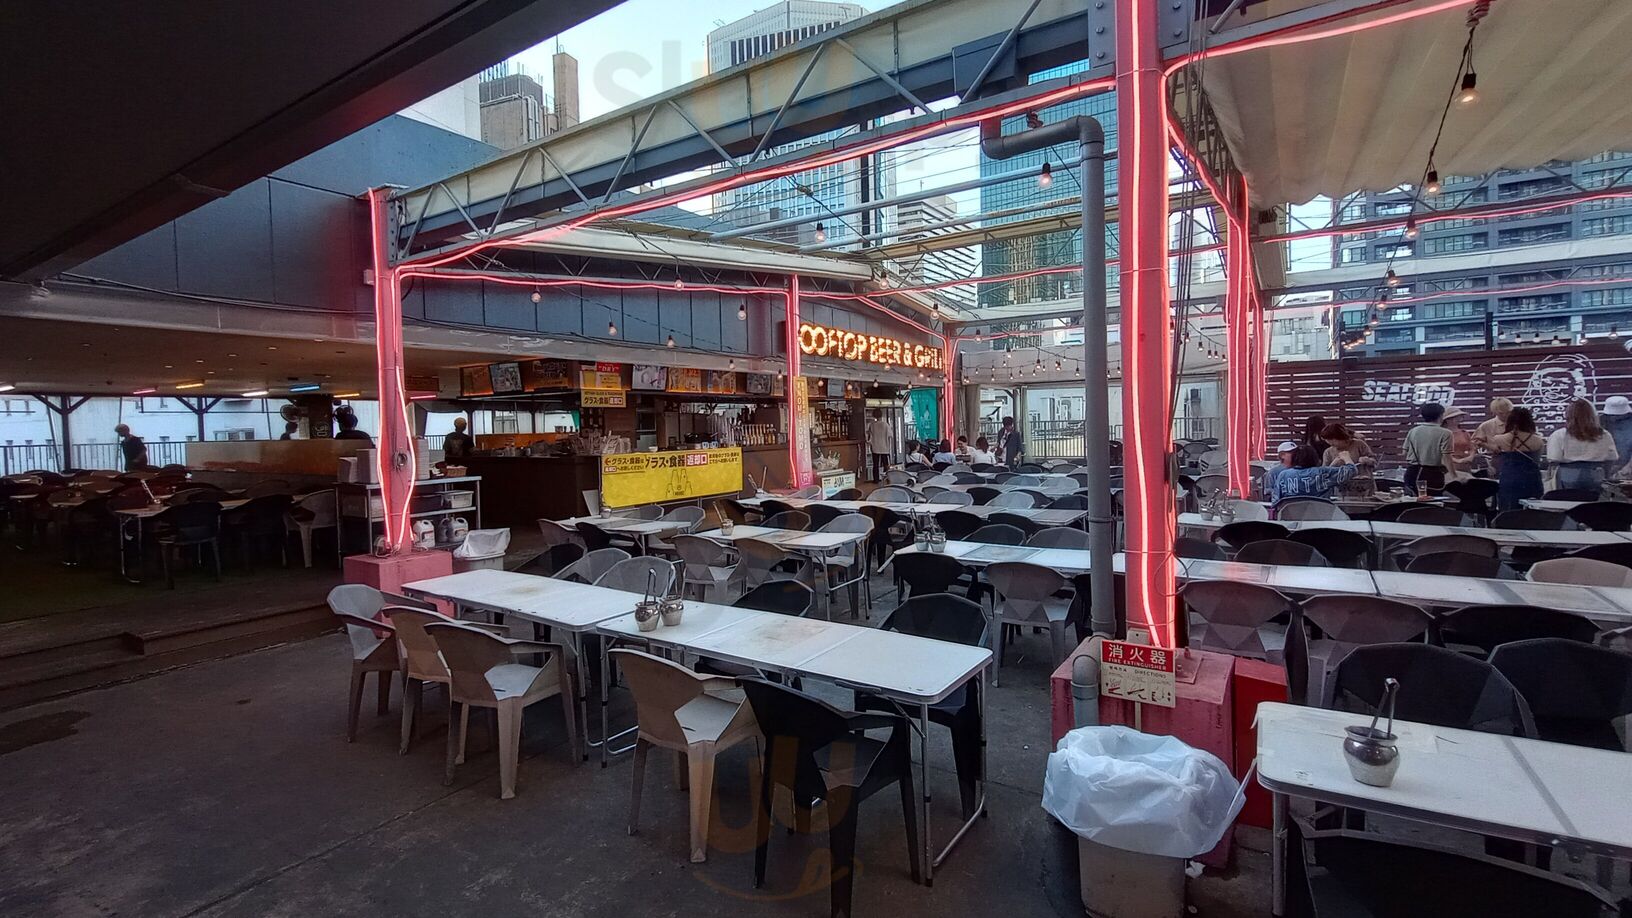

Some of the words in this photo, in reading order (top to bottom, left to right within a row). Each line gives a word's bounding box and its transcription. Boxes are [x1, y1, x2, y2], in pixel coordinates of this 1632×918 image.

[799, 324, 867, 361] OOFTOP
[869, 336, 901, 364] BEER
[903, 342, 913, 366] &
[1361, 379, 1455, 408] SEAFOOD
[1108, 643, 1167, 666] 消火器
[1123, 660, 1167, 671] EXTINGUISHER
